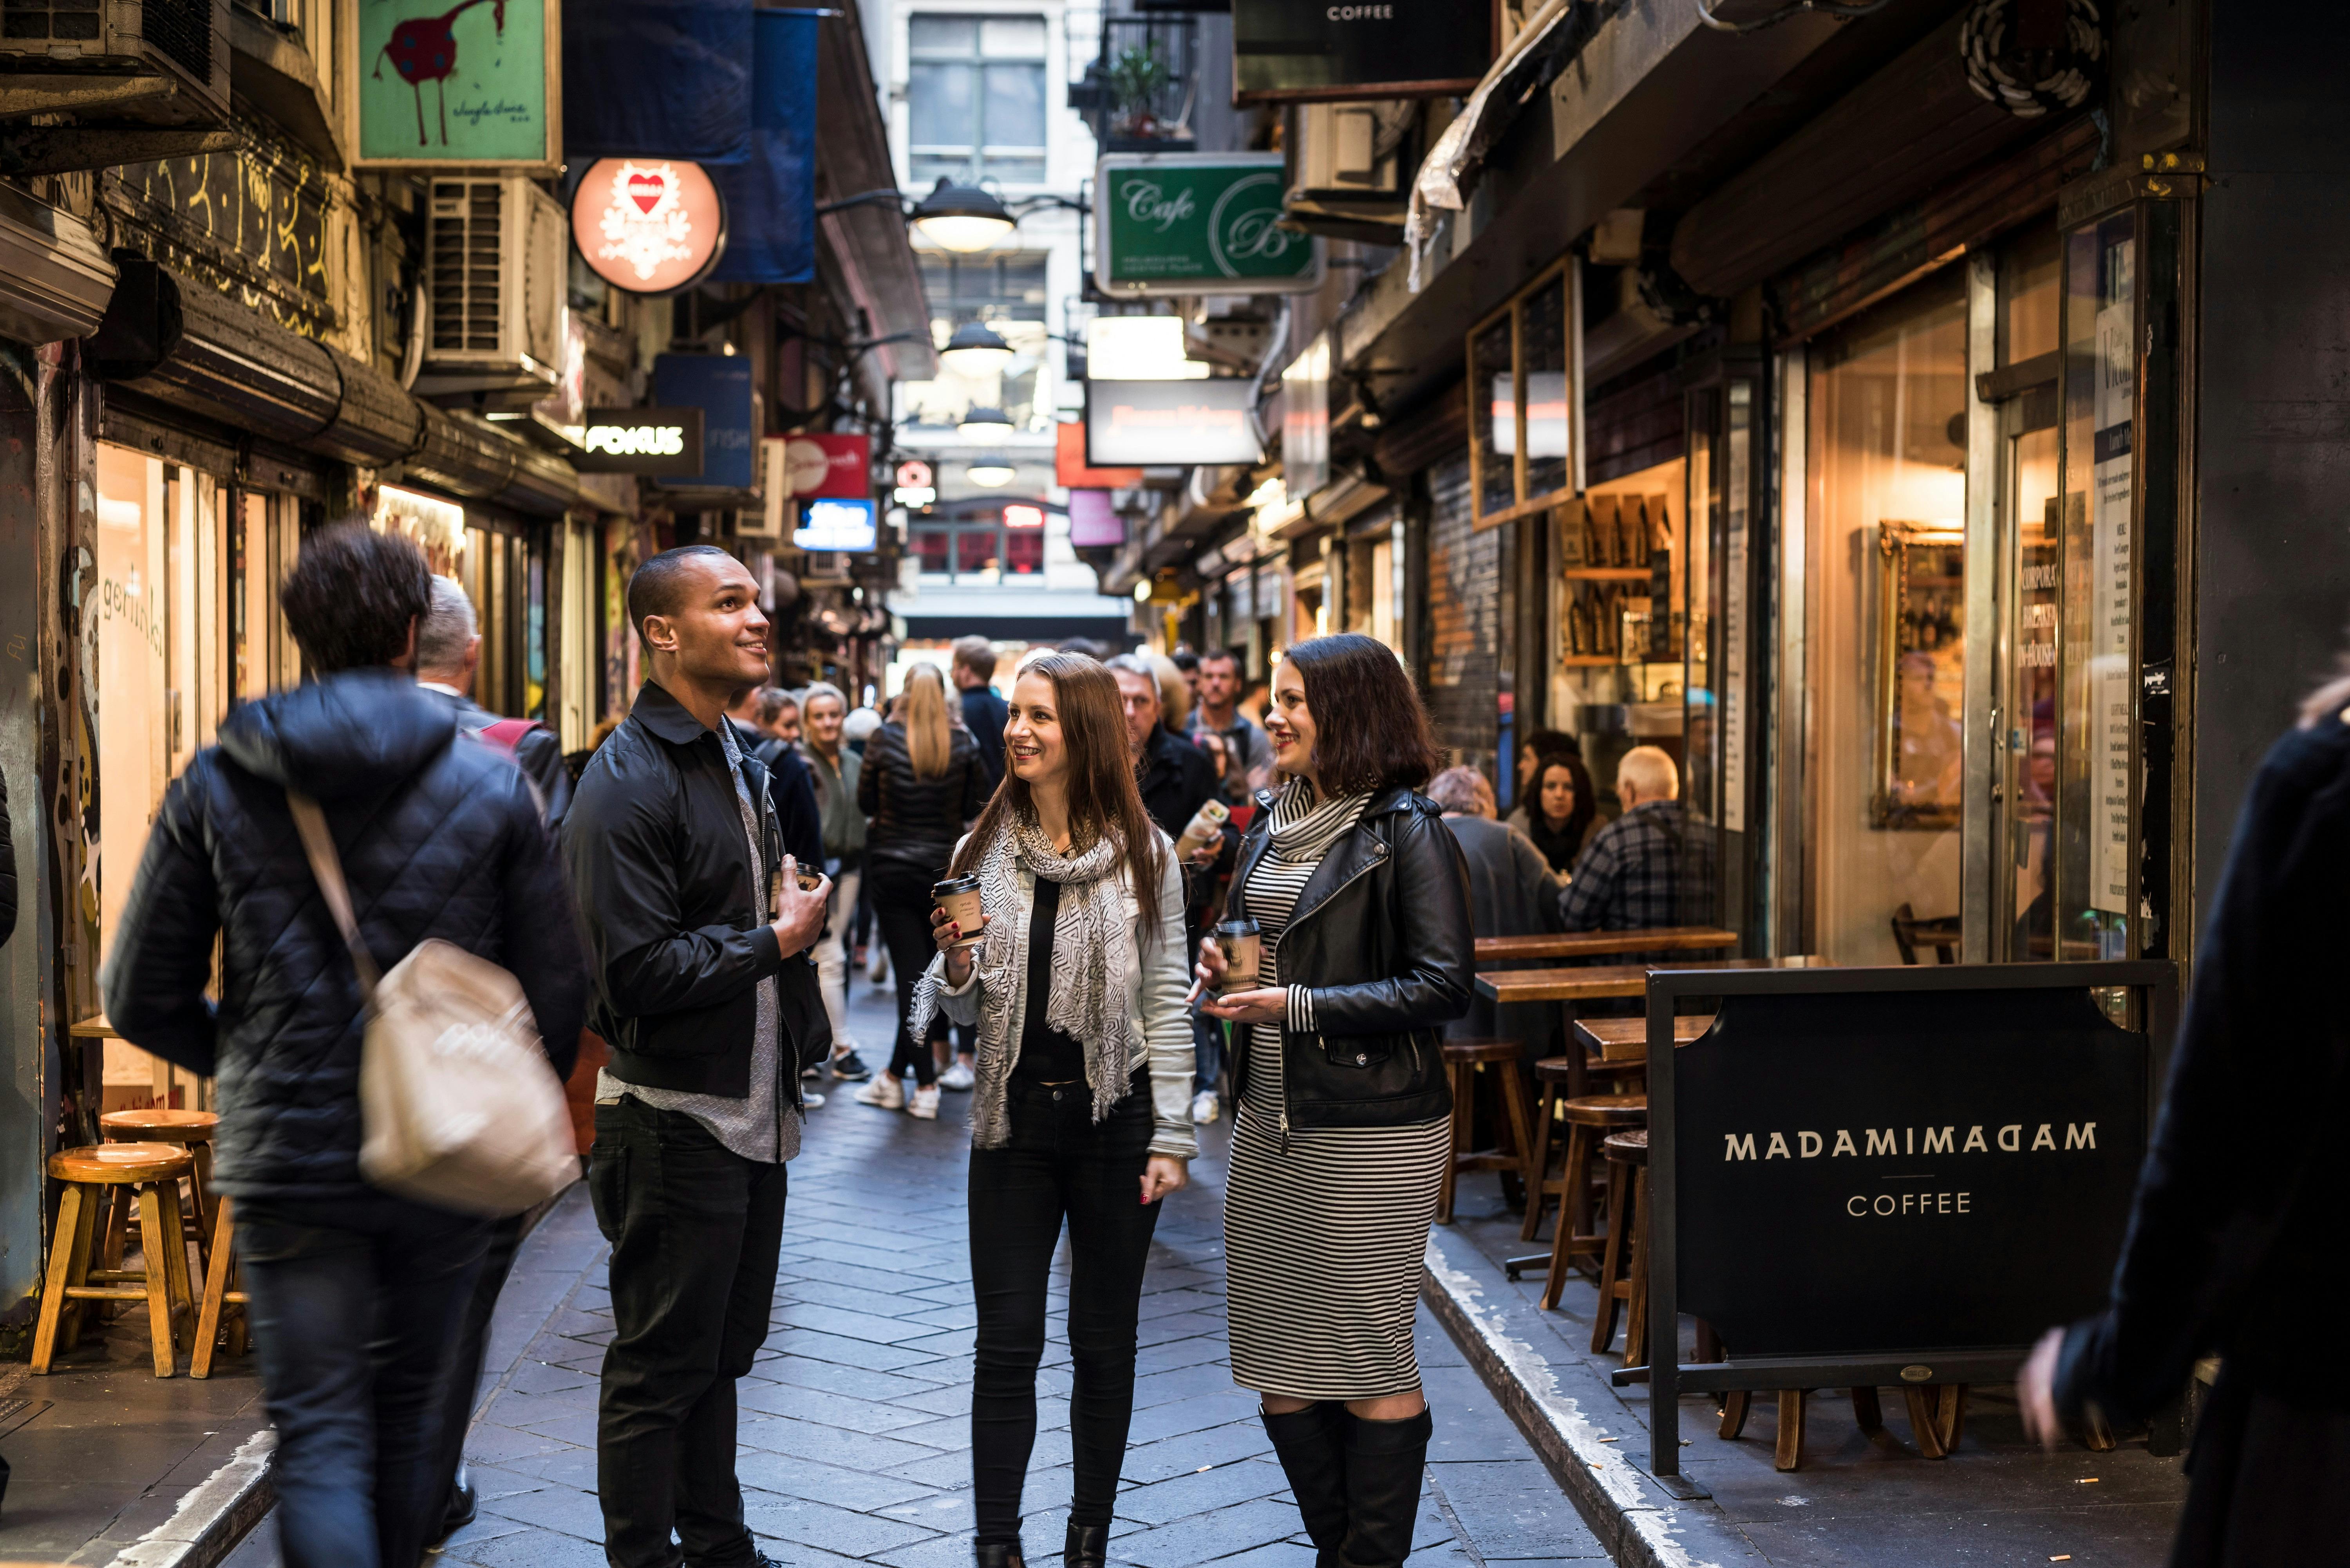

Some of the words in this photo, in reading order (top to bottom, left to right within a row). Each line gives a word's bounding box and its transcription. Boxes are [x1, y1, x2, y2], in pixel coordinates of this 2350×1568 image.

[1326, 4, 1394, 22] COFFEE
[586, 425, 684, 455] FOKUS
[2022, 563, 2057, 590] CORPORA
[1724, 1122, 2097, 1162] MADAMIMADAM
[1847, 1192, 1971, 1217] COFFEE
